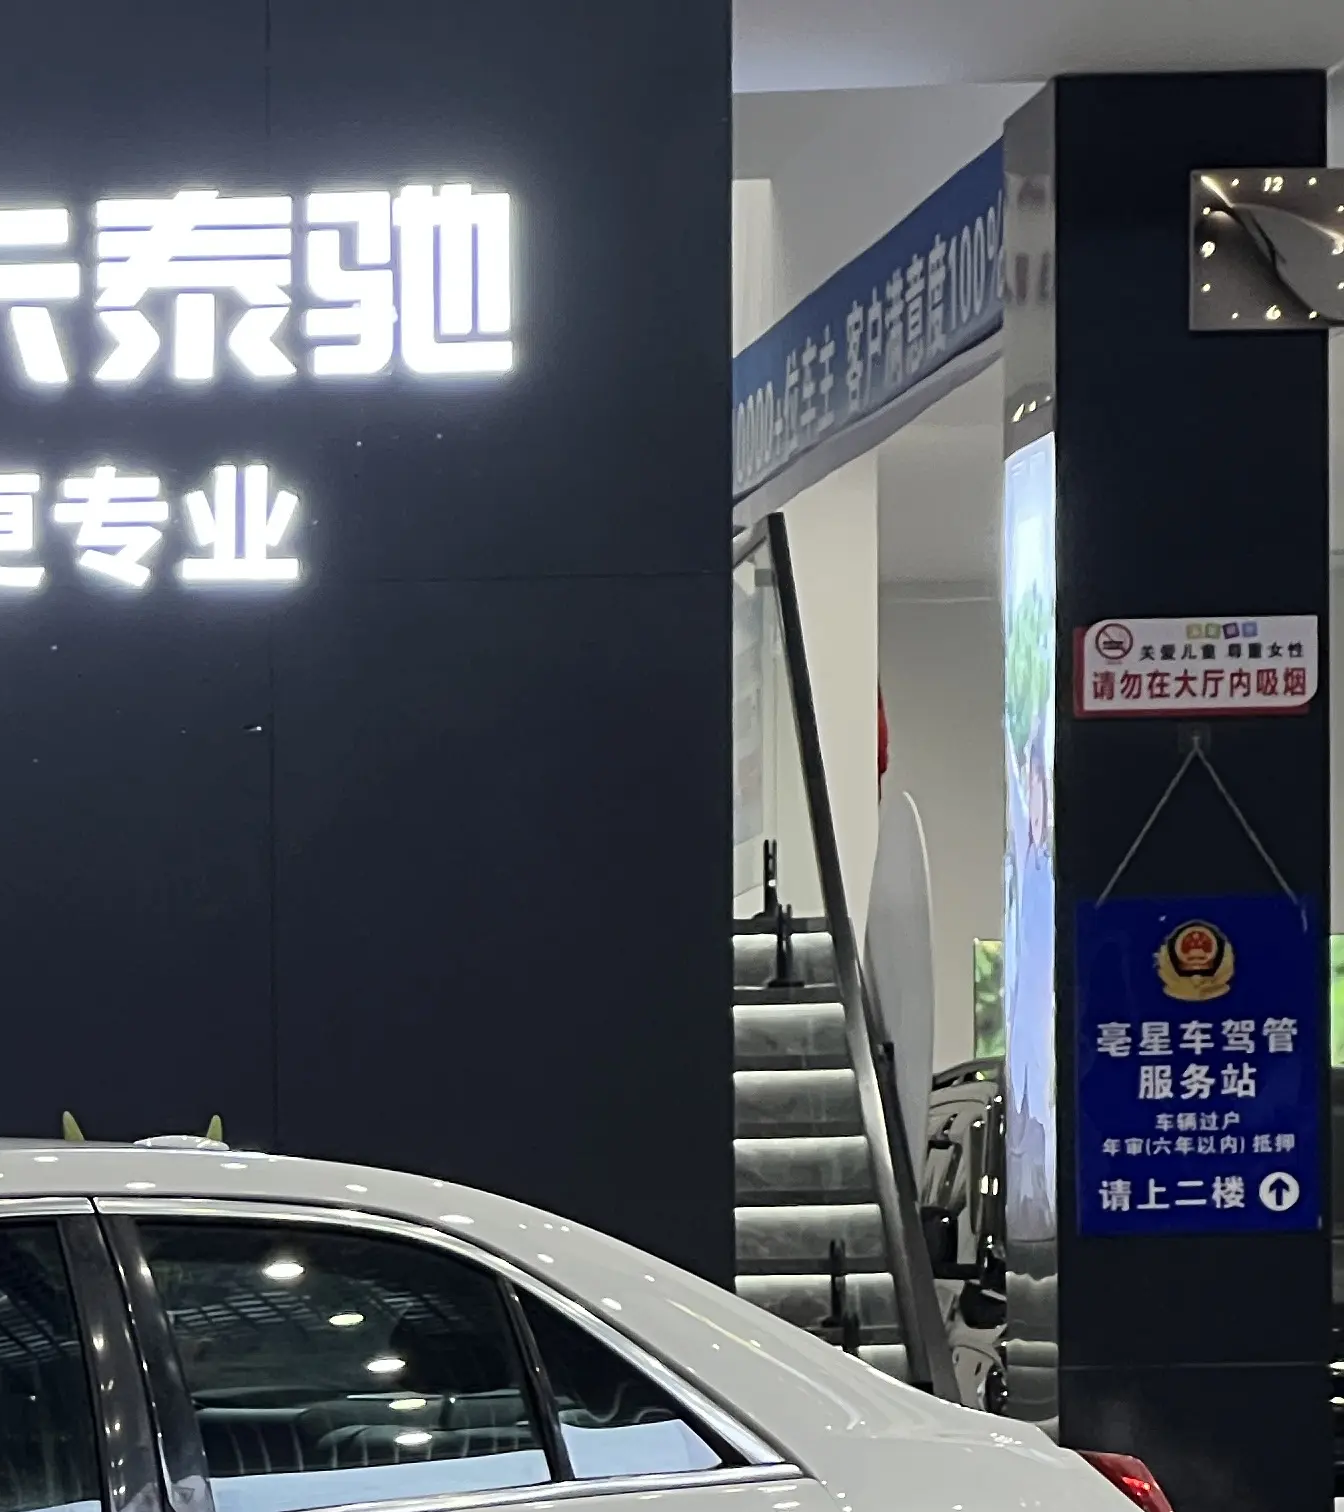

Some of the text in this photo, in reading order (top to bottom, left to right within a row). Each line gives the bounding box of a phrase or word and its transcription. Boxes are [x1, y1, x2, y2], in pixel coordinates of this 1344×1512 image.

[1263, 176, 1285, 193] 12
[1201, 241, 1216, 258] 9
[1265, 305, 1281, 320] 6
[1139, 640, 1304, 661] 关爱儿童 尊重女性
[1092, 666, 1306, 700] 请勿在大厅内吸烟
[1139, 1062, 1257, 1099] 服务站
[1155, 1110, 1240, 1132] 车辆过户
[1102, 1136, 1245, 1156] 年审(六年以内)
[1098, 1176, 1245, 1212] 请上二楼
